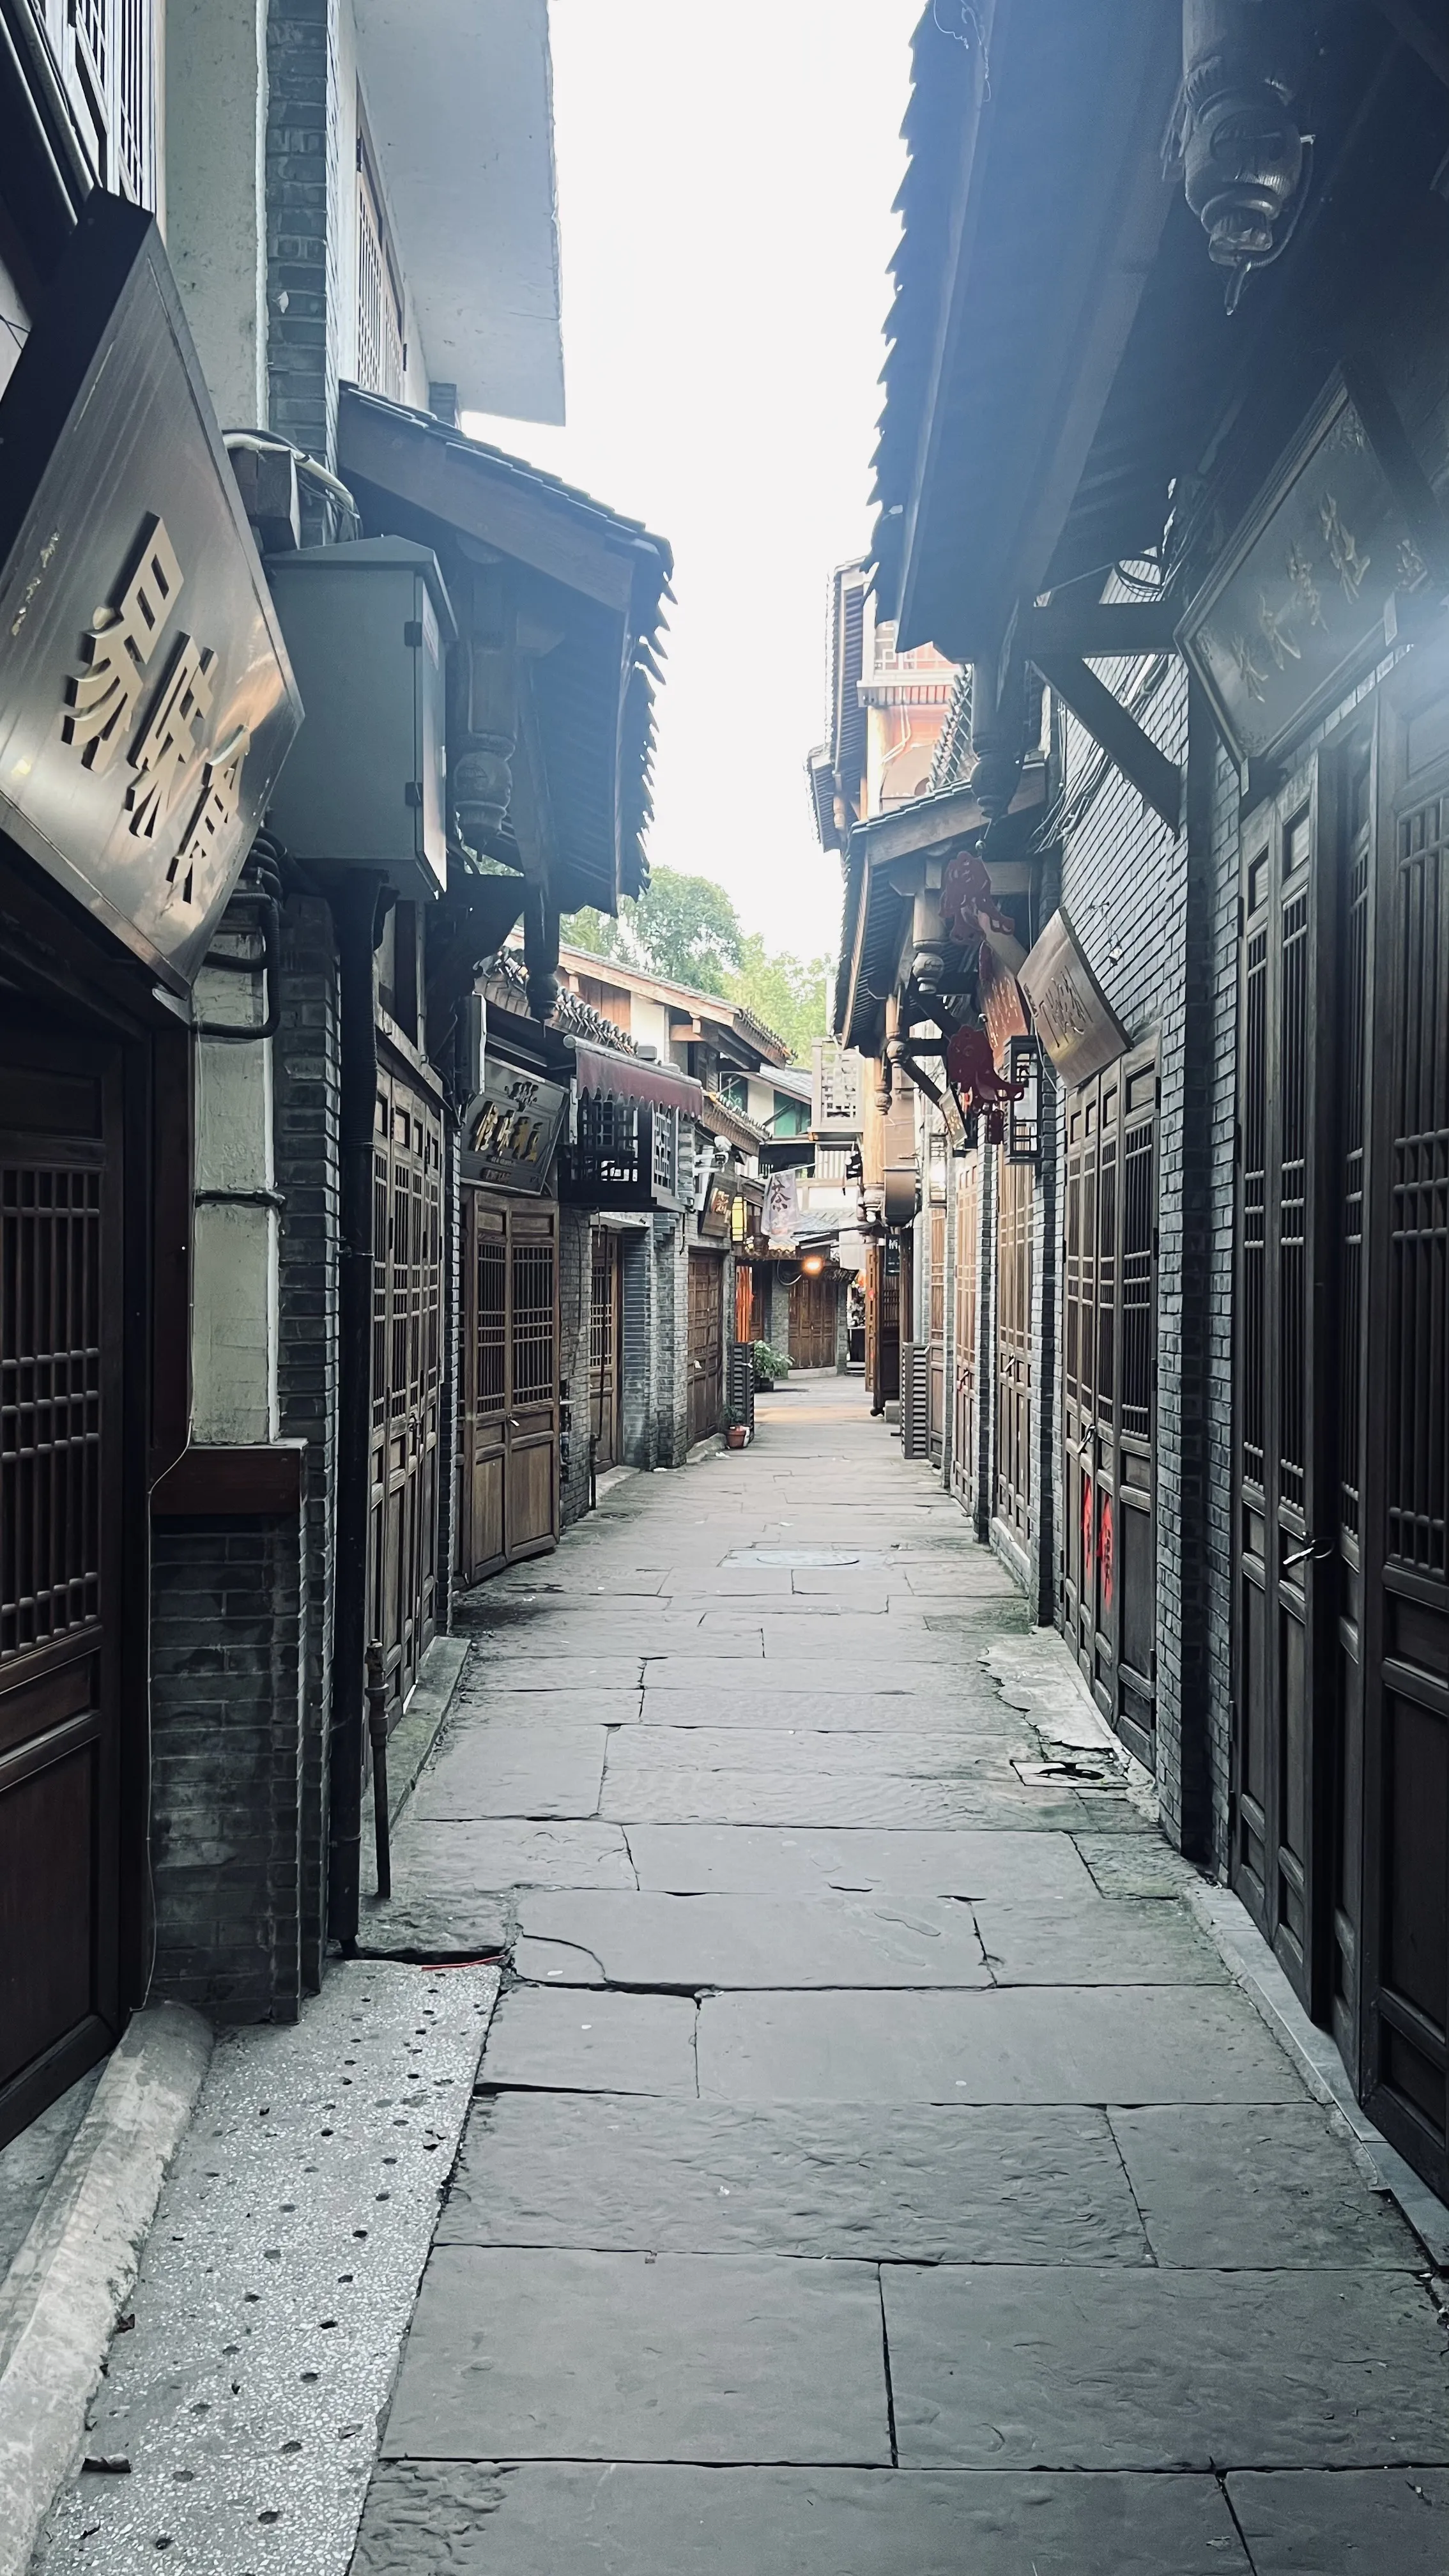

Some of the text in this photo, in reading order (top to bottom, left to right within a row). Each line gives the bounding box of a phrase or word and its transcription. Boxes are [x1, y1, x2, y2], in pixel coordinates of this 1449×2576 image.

[62, 512, 251, 904] 易味食
[770, 1179, 791, 1212] 茶
